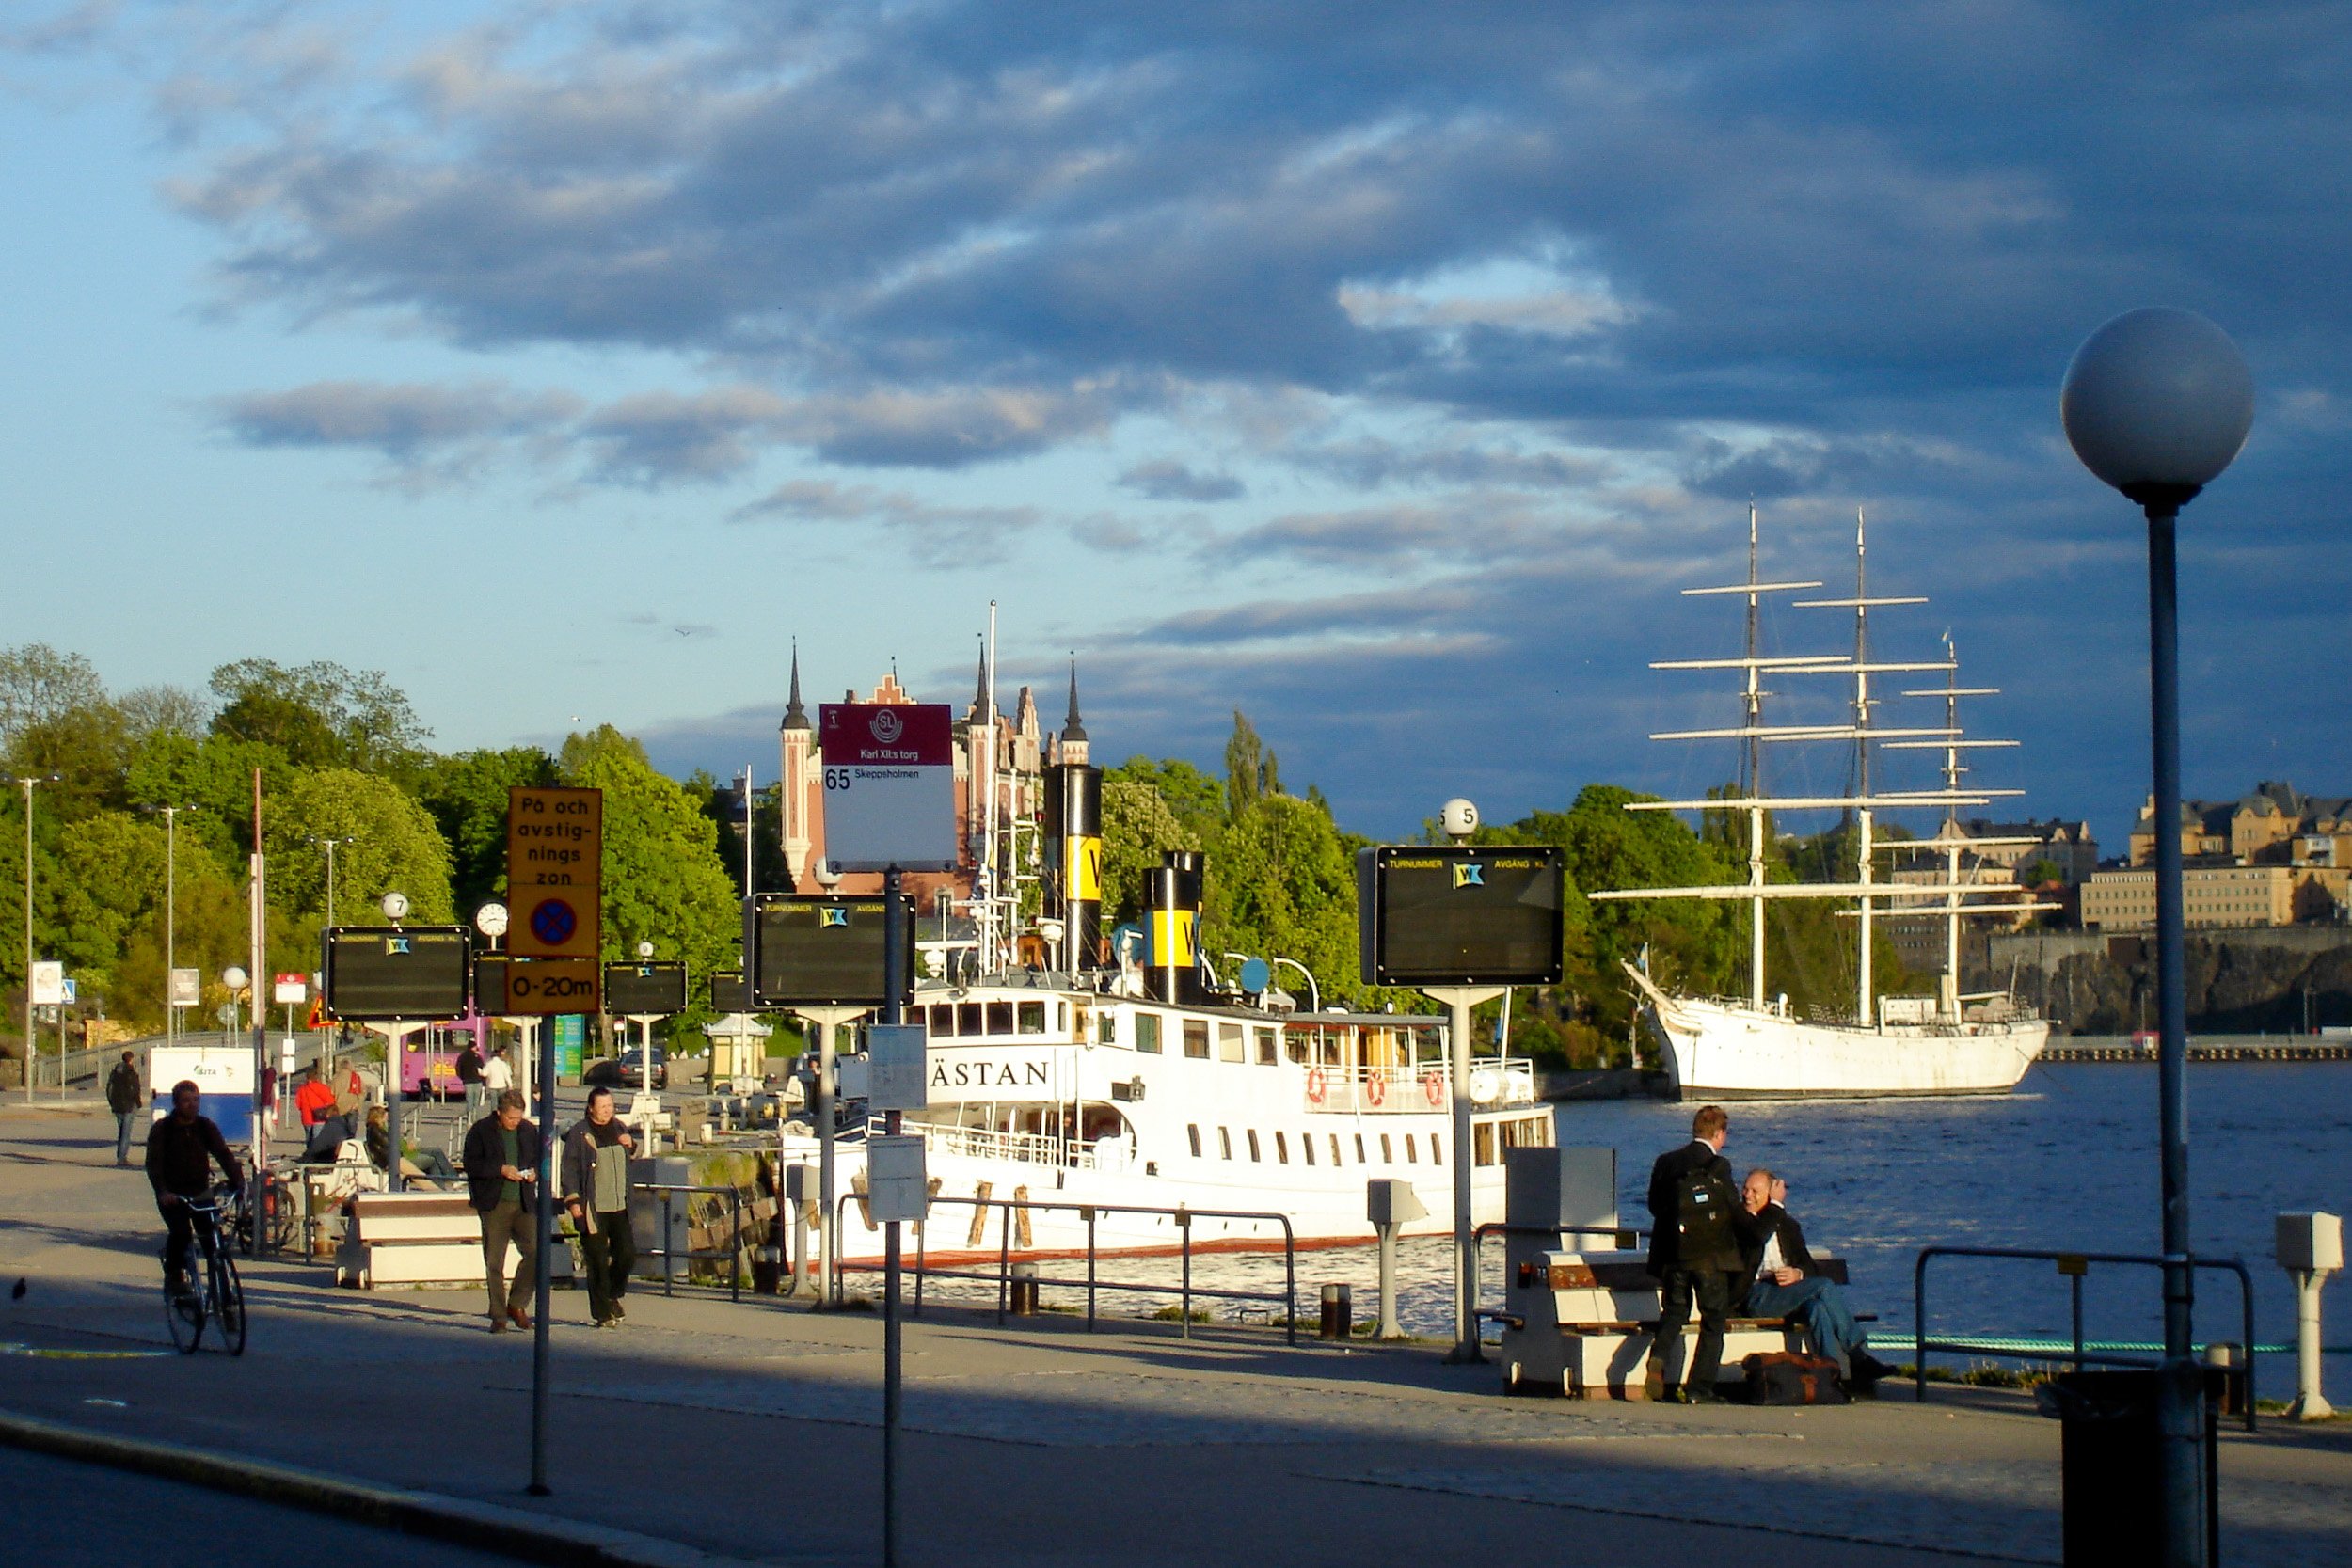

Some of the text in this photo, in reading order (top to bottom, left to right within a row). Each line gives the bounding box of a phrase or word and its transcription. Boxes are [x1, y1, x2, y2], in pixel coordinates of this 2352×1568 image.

[831, 715, 836, 725] 1
[860, 749, 879, 759] Karl
[899, 750, 919, 761] torg
[825, 768, 919, 790] 65 Skeppsholmen
[555, 799, 589, 815] och
[1463, 808, 1474, 824] 5
[518, 821, 592, 841] avstig-
[528, 845, 580, 864] nings
[536, 872, 572, 886] zon
[396, 899, 405, 912] 7
[930, 1057, 1049, 1087] ÄSTAN
